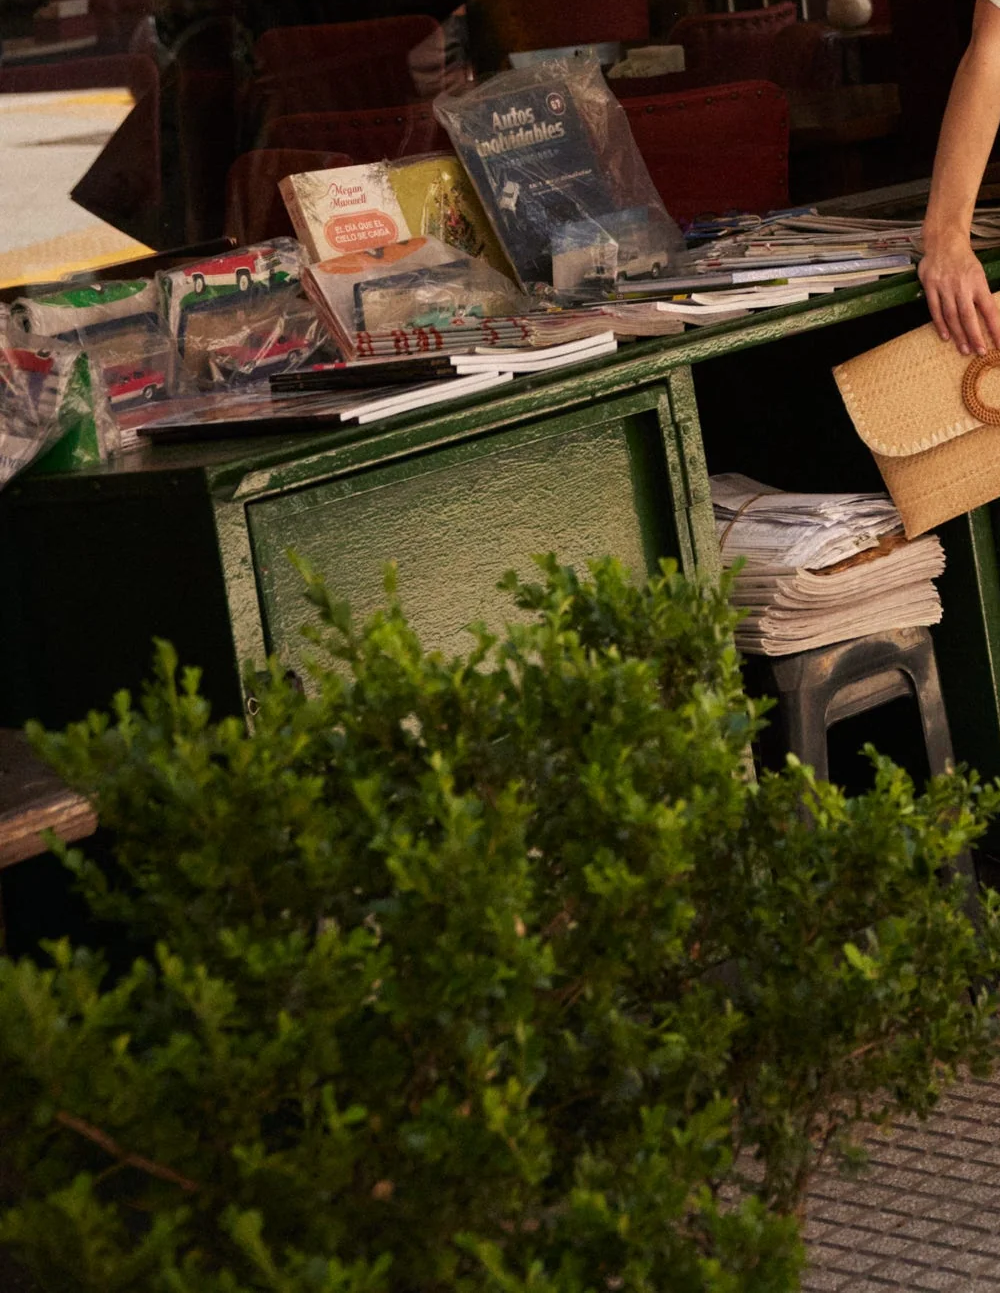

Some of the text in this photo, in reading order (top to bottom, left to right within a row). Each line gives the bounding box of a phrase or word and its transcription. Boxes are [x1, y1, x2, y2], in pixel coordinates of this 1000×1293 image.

[492, 107, 536, 134] Autos
[475, 121, 566, 158] inolvidables
[328, 182, 364, 197] Megan
[330, 193, 367, 208] Maxwell
[334, 225, 346, 235] EL
[357, 220, 374, 231] QUE
[373, 219, 385, 227] EL
[335, 233, 358, 244] CIELO
